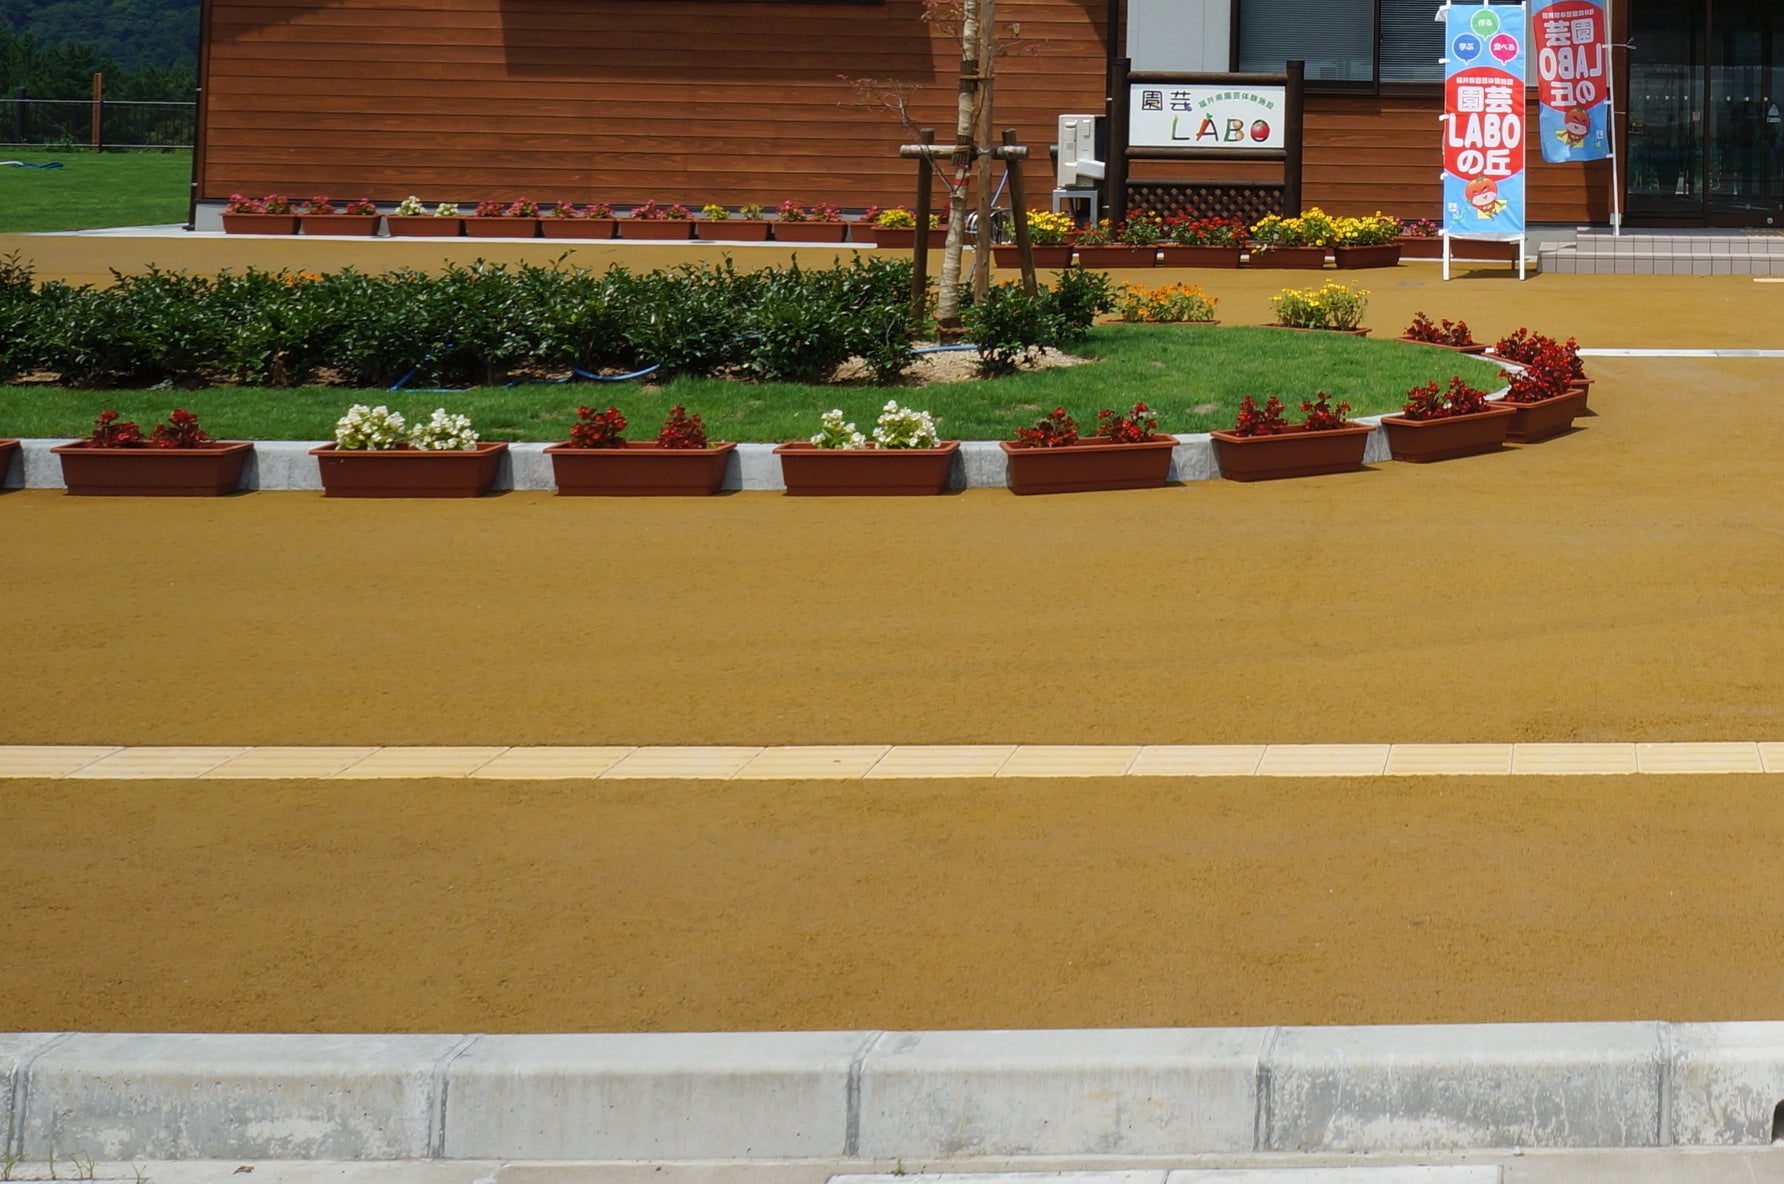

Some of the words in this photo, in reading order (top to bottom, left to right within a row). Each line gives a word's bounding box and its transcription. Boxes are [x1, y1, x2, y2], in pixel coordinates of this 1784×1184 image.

[1493, 42, 1515, 51] 食べる
[1141, 90, 1192, 112] 園芸
[1457, 86, 1513, 113] 園芸
[1171, 113, 1270, 142] LABO
[1449, 113, 1521, 149] LABO
[1457, 149, 1512, 177] の丘
